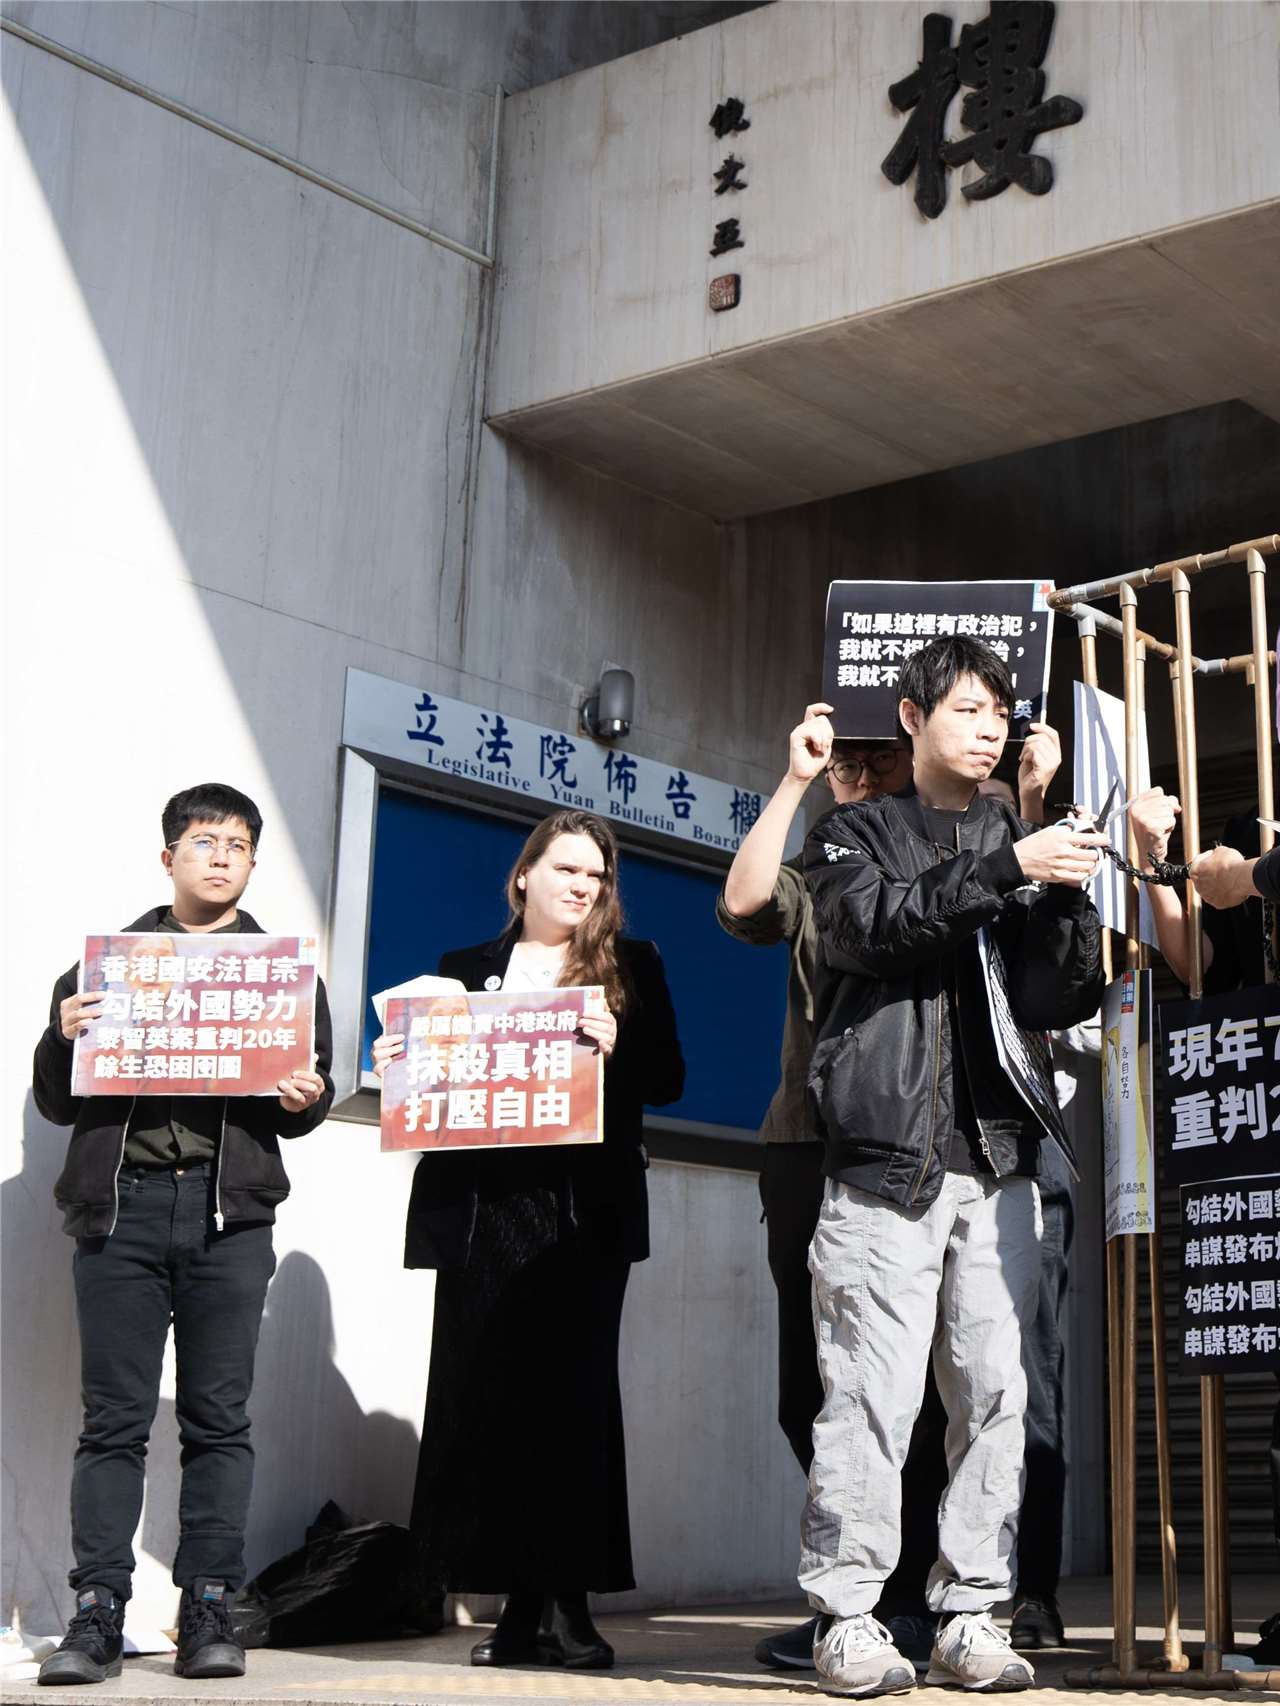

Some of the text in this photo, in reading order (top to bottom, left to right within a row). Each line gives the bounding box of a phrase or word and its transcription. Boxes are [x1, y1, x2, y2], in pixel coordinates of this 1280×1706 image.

[406, 692, 761, 835] 立法院佈告欄
[427, 750, 740, 850] Legislative Yuan Bulletin Board
[101, 956, 299, 984] 香港國安法首宗
[101, 989, 297, 1022] 勾結外國勢力
[97, 1027, 296, 1050] 黎智英案重判20年
[406, 1039, 573, 1086] 抹殺真相
[404, 1085, 570, 1132] 打壓自由
